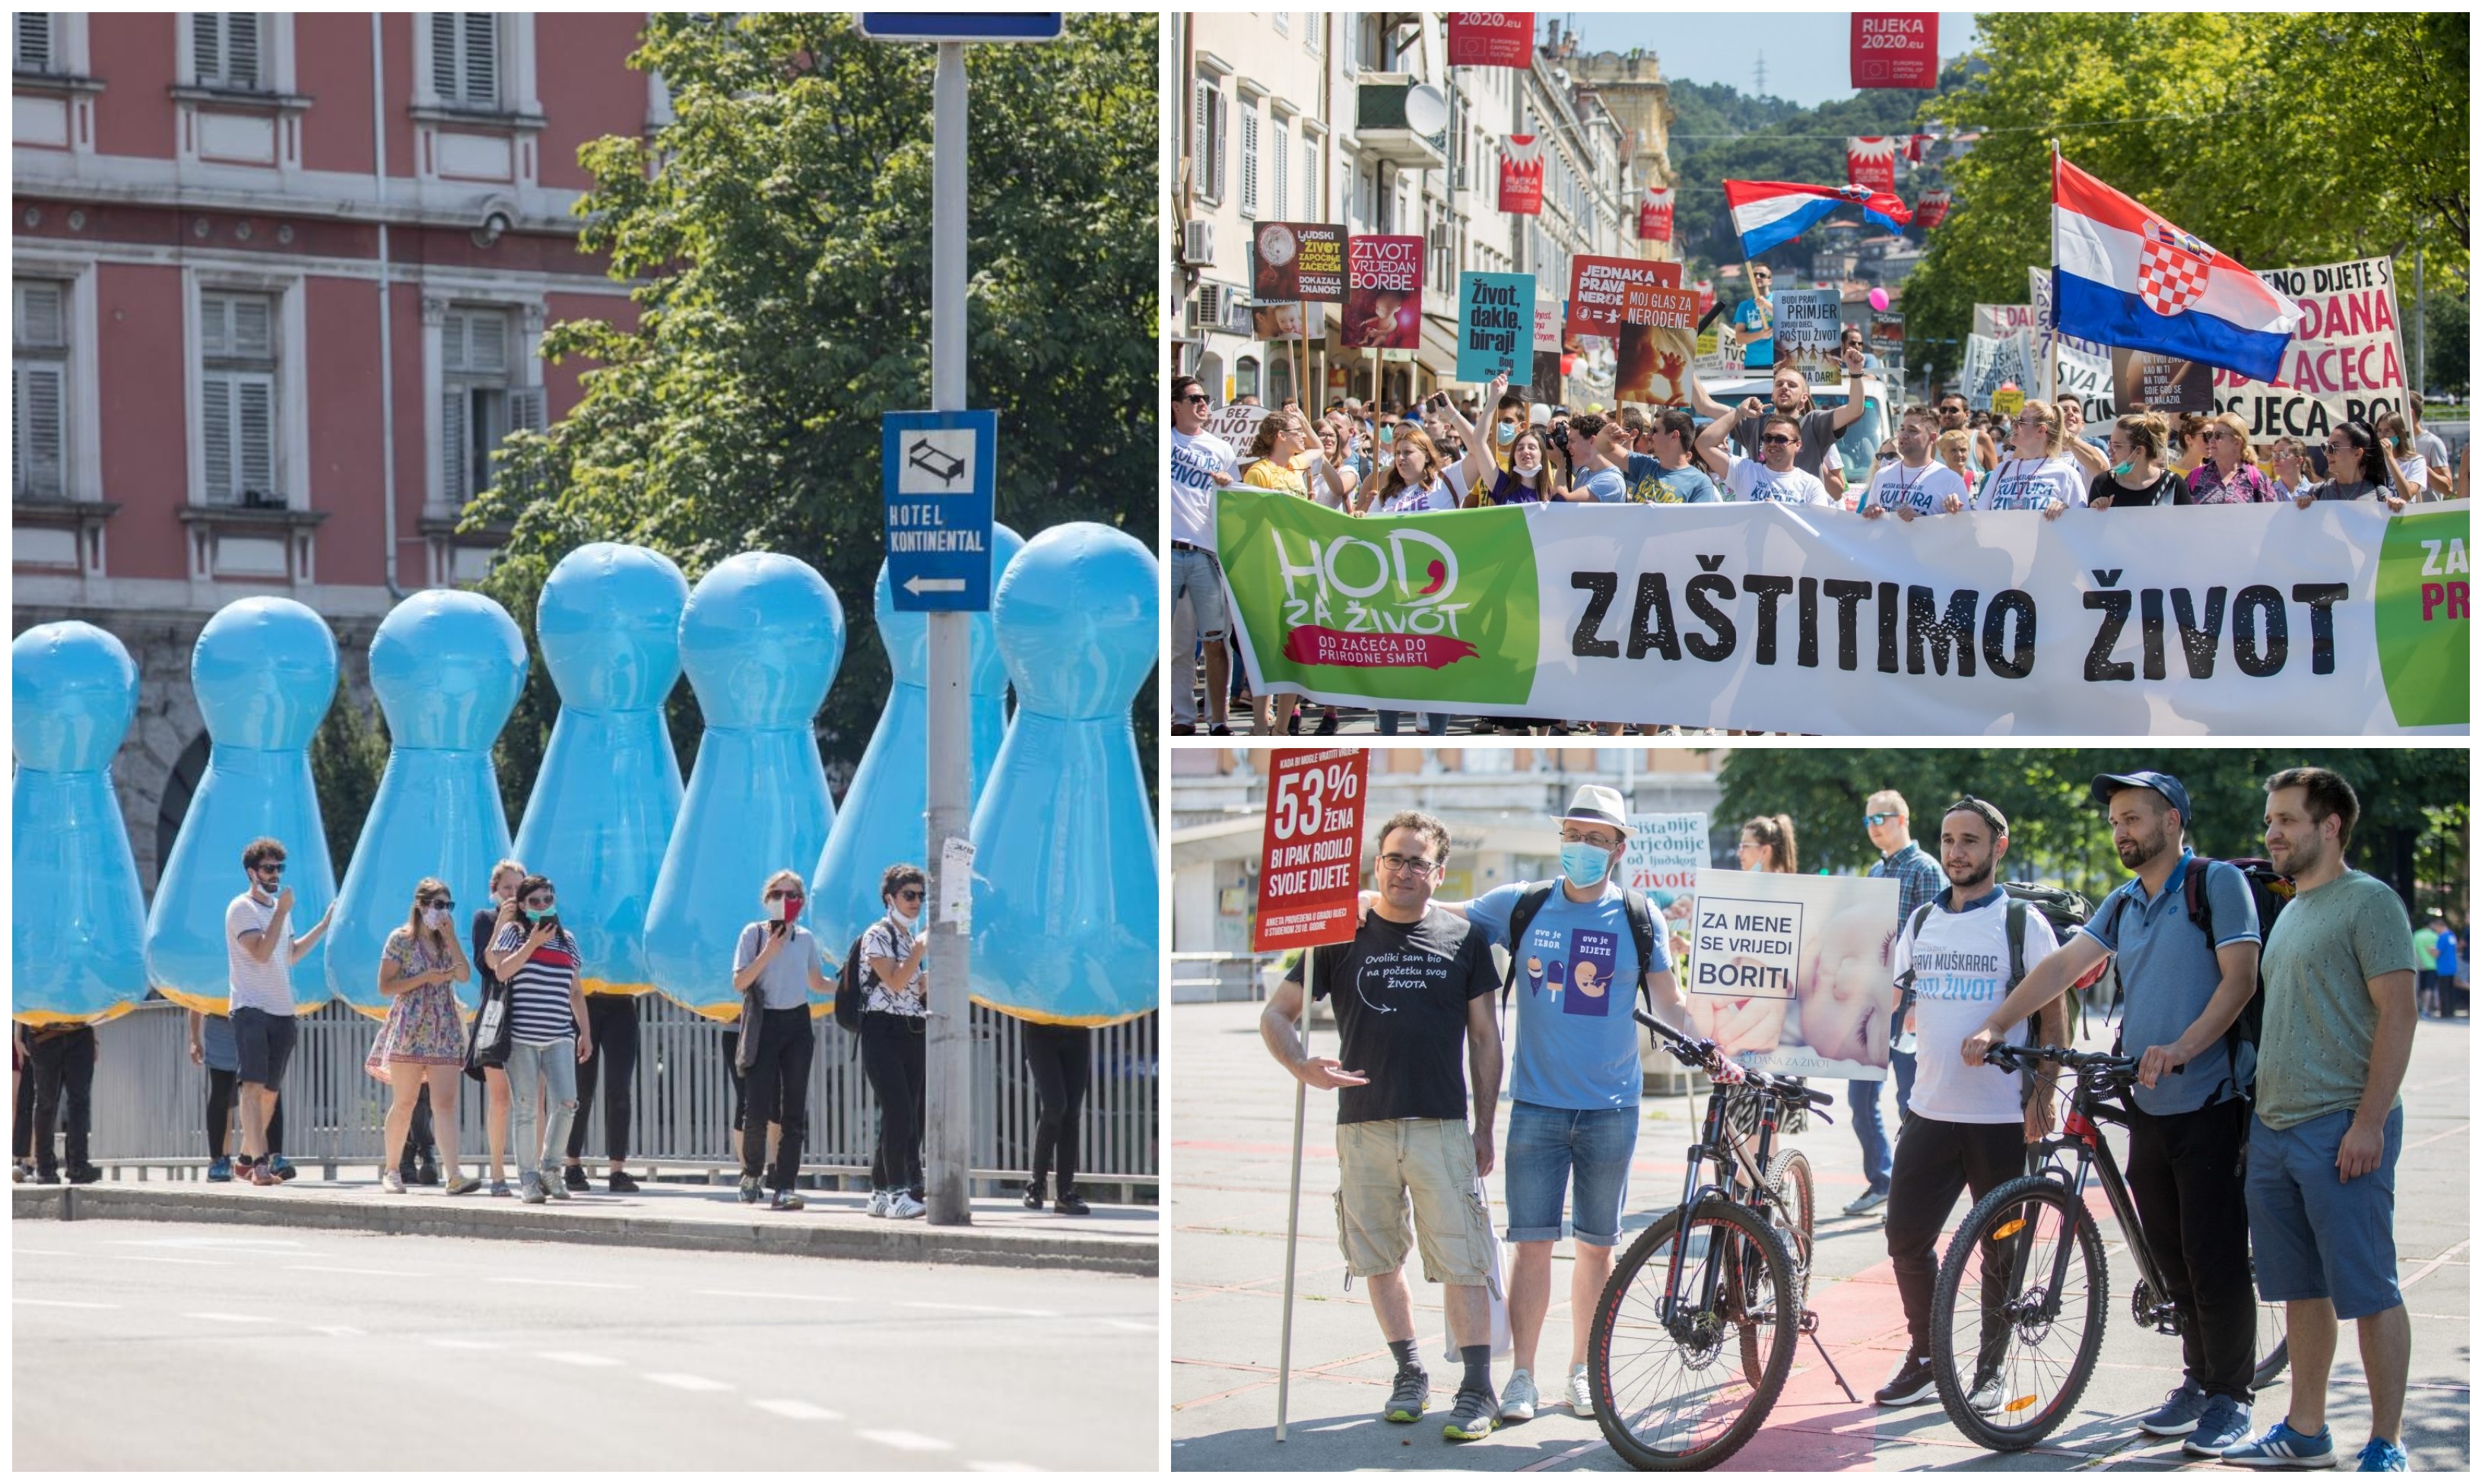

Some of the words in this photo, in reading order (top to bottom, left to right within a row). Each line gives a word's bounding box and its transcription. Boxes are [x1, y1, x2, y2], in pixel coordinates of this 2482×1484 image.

[1458, 12, 1521, 28] 2020.eu
[1862, 18, 1924, 33] RIJEKA
[1862, 34, 1924, 49] 2020.eu
[1505, 176, 1538, 186] RIJEKA
[1304, 240, 1341, 253] ŽIVOT
[1351, 239, 1416, 260] ŽIVOT.
[1299, 262, 1341, 272] ZAČEĆEM
[1351, 259, 1416, 274] VRIJEDAN
[1581, 265, 1655, 284] JEDNAKA
[1299, 276, 1341, 285] DOKAZALA
[1350, 272, 1414, 291] BORBE.
[1579, 277, 1625, 293] PRAVA
[2313, 262, 2373, 293] DIJETE
[1300, 284, 1341, 295] ZNANOST
[1471, 278, 1520, 309] Život,
[1630, 291, 1648, 307] MOJ
[1652, 293, 1675, 310] GLAS
[1678, 296, 1691, 312] ZA
[1782, 295, 1797, 304] BUDI
[1798, 295, 1817, 304] PRAVI
[1471, 305, 1522, 331] dakle,
[1627, 307, 1690, 330] NEROĐENE
[1788, 304, 1837, 320] PRIMJER
[1469, 328, 1516, 355] biraj!
[1779, 328, 1811, 341] POŠTUJ
[1814, 326, 1836, 341] ŽIVOT
[1499, 357, 1514, 369] Bog
[2144, 366, 2156, 375] KAO
[1815, 372, 1833, 382] DAR!
[2058, 360, 2097, 392] SVA
[2144, 376, 2153, 385] NA
[2144, 386, 2158, 395] GDJE
[2160, 385, 2173, 394] GOD
[2173, 385, 2182, 394] SE
[1226, 407, 1251, 419] BEZ
[1172, 446, 1220, 473] KULTURA
[1997, 482, 2054, 496] KULTURA
[1880, 490, 1933, 510] KULTURA
[1993, 495, 2051, 510] ŽITA
[890, 505, 943, 525] HOTEL
[891, 530, 985, 552] KONTINENTAL
[2421, 537, 2469, 576] ZA
[1271, 528, 1459, 607] HOD
[1284, 592, 1336, 628] ZA
[1344, 599, 1471, 639] ŽIVOT
[1571, 554, 2036, 680] ZAŠTITIMO
[2084, 569, 2350, 683] ŽIVOT
[1319, 636, 1337, 649] OD
[1342, 636, 1398, 652] ZAČEĆA
[1405, 639, 1427, 652] DO
[1319, 649, 1382, 664] PRIRODNE
[1387, 651, 1428, 663] SMRTI
[1280, 757, 1295, 769] KADA
[1295, 756, 1301, 766] BI
[1301, 753, 1318, 765] MOGLE
[1319, 750, 1338, 762] VRATITI
[1274, 761, 1357, 840] 53%
[1323, 807, 1354, 833] ŽENA
[1668, 817, 1697, 835] nije
[1271, 848, 1282, 869] BI
[1285, 844, 1311, 867] IPAK
[1313, 836, 1352, 864] RODILO
[1627, 854, 1644, 865] od
[1650, 855, 1696, 867] ljudskog
[1269, 870, 1306, 898] SVOJE
[1309, 864, 1350, 892] DIJETE
[1266, 915, 1284, 926] ANKETA
[1284, 912, 1312, 925] PROVEDENA
[1312, 912, 1316, 921] U
[1316, 910, 1331, 921] GRADU
[1332, 907, 1347, 918] RIJECI
[1702, 912, 1728, 930] ZA
[1735, 915, 1792, 934] MENE
[1265, 928, 1268, 937] U
[1269, 924, 1294, 936] STUDENOM
[1309, 921, 1326, 931] GODINE
[1535, 928, 1550, 937] ovo
[1552, 930, 1561, 940] je
[1534, 938, 1560, 950] IZBOR
[1582, 935, 1598, 943] ovo
[1600, 936, 1608, 945] je
[1700, 936, 1723, 951] SE
[1729, 937, 1792, 955] VRIJEDI
[1579, 945, 1611, 956] DIJETE
[1366, 953, 1399, 965] Ovoliki
[1427, 953, 1442, 963] bio
[1935, 950, 1998, 972] MUŠKARAC
[1382, 966, 1422, 978] početku
[1425, 968, 1447, 978] svog
[1699, 962, 1788, 989] BORITI
[1387, 977, 1427, 989] ŽIVOTA
[1942, 973, 1997, 1001] ŽIVOT
[1754, 1056, 1782, 1066] DANA
[1785, 1058, 1798, 1067] ZA
[1800, 1057, 1831, 1068] ŽIVOT
[2093, 1243, 2102, 1270] ROB
